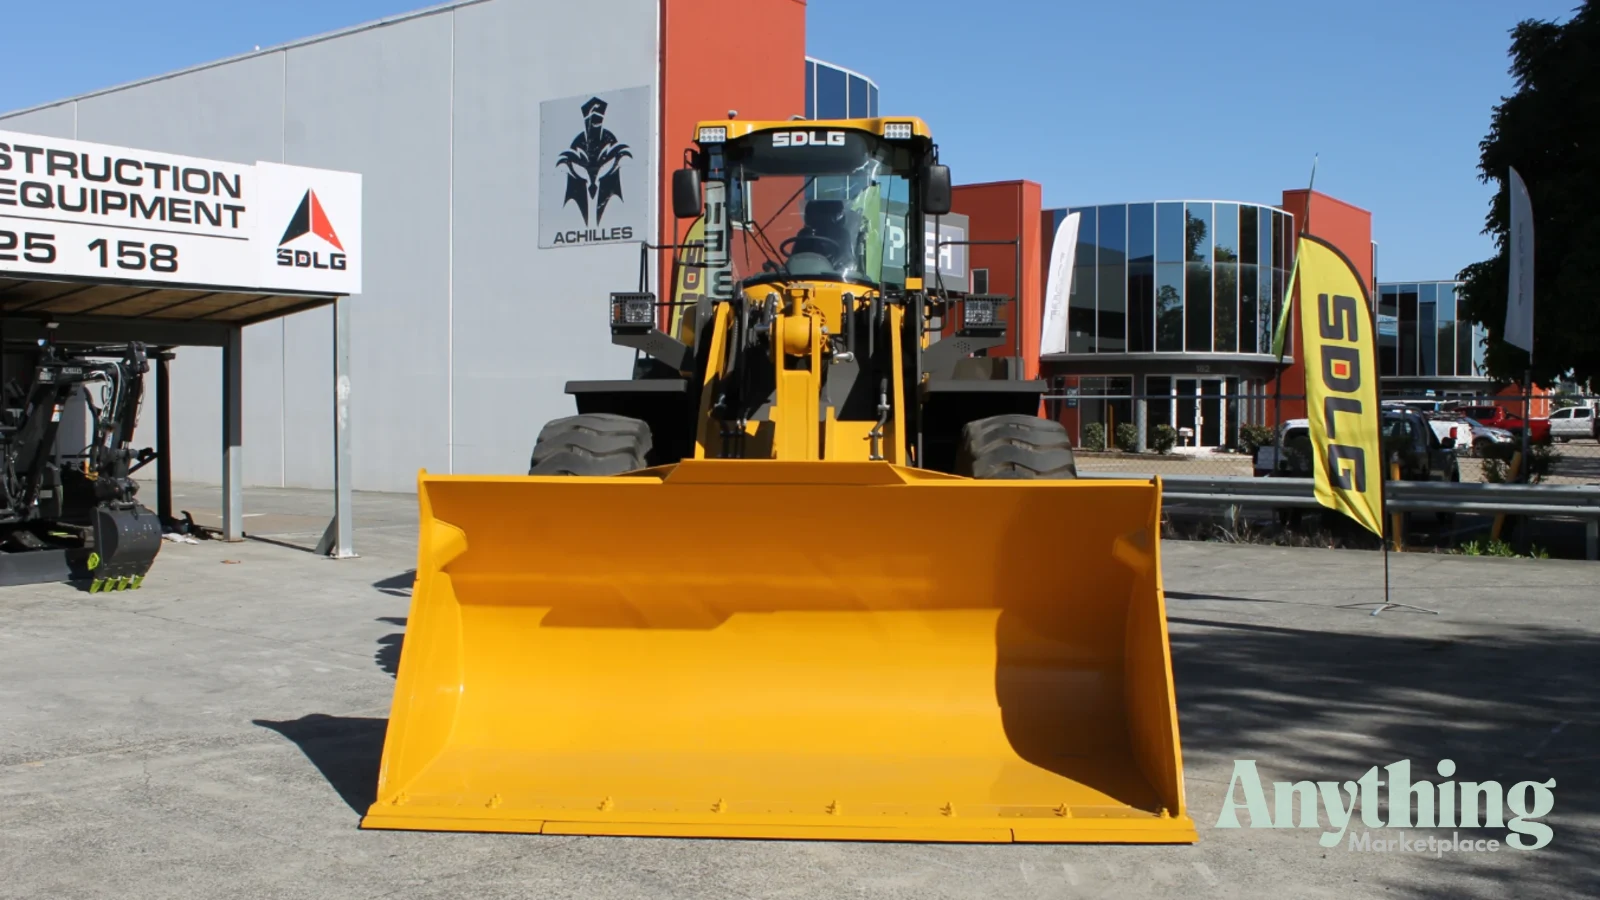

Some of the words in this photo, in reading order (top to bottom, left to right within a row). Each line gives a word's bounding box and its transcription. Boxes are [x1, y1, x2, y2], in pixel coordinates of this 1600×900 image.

[772, 131, 845, 147] SDLG
[0, 178, 245, 229] EQUIPMENT
[553, 226, 633, 244] ACHILLES
[88, 238, 178, 273] 158
[276, 248, 347, 271] SDLG
[1317, 293, 1367, 493] SDLG
